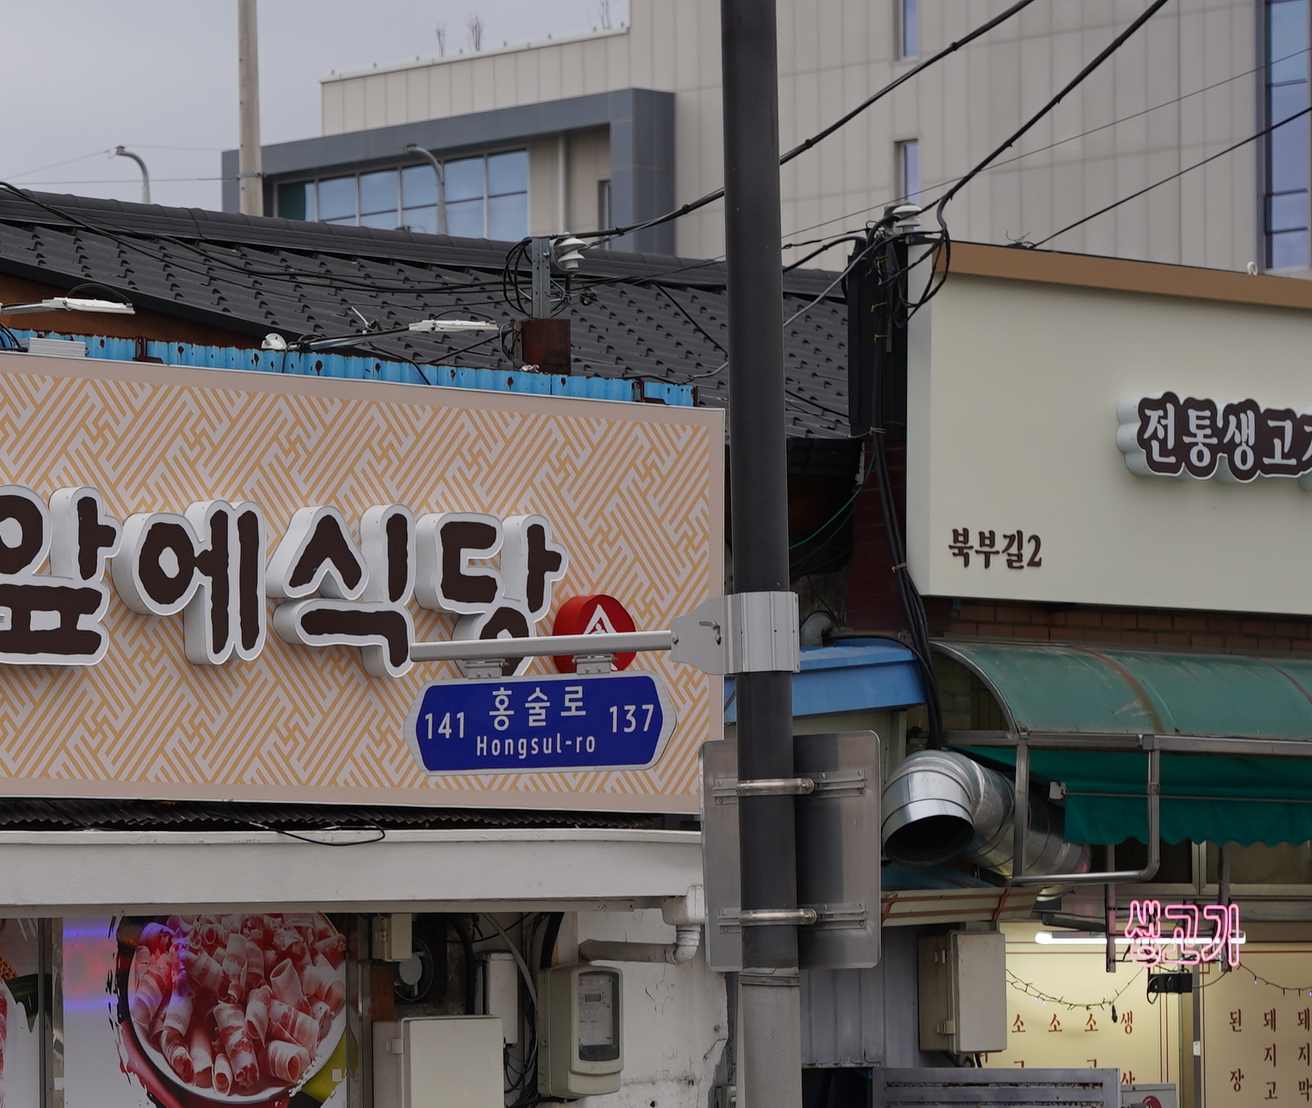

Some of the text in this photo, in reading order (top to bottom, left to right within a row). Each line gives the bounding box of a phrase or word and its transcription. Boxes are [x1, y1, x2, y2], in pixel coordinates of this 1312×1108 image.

[1143, 403, 1312, 471] 전통생고
[949, 528, 1042, 569] 북부길2
[425, 686, 654, 739] 141 홍술로 137
[476, 732, 596, 759] Hongsul-ro
[1125, 899, 1240, 968] 생고기
